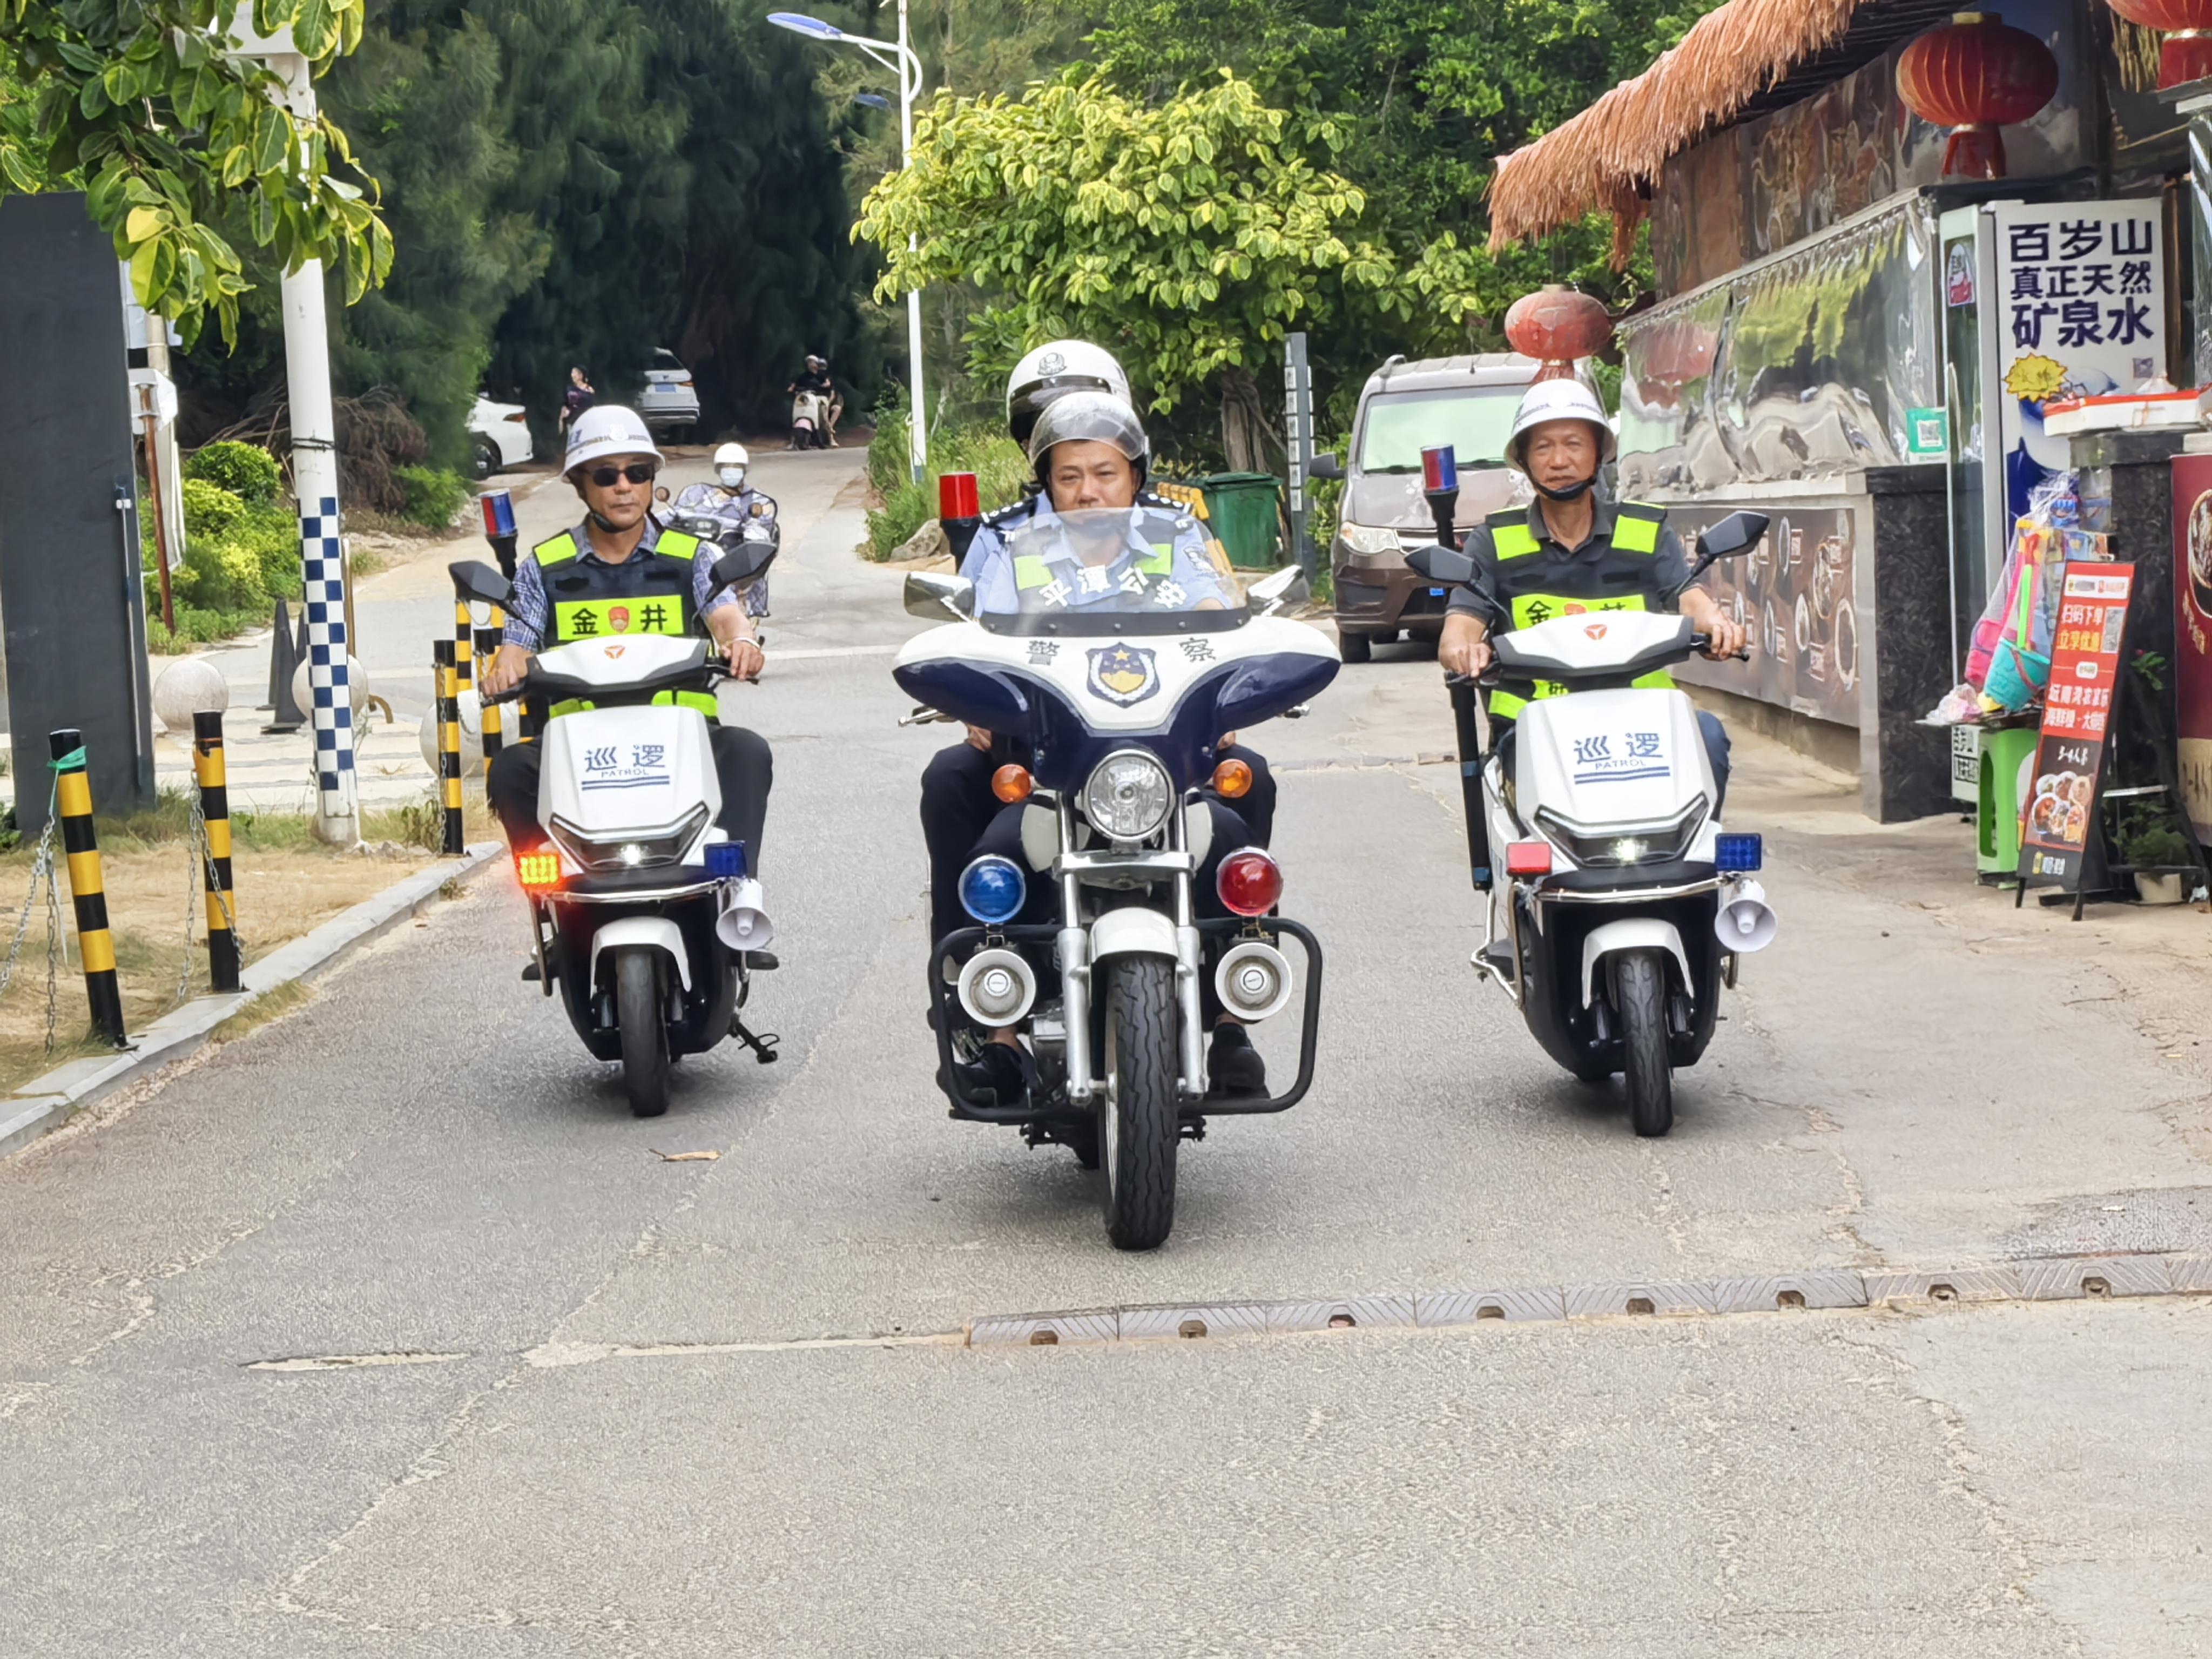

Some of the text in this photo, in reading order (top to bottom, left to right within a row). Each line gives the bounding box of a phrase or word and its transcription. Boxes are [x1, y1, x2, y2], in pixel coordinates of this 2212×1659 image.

[2008, 218, 2153, 262] 百岁山
[2010, 261, 2152, 300] 真正天然
[2011, 296, 2154, 349] 矿泉水
[572, 608, 598, 635] 金
[584, 744, 665, 772] 巡逻
[1574, 732, 1663, 765] 巡逻
[601, 768, 649, 778] PATROL
[1595, 759, 1646, 770] PATROL
